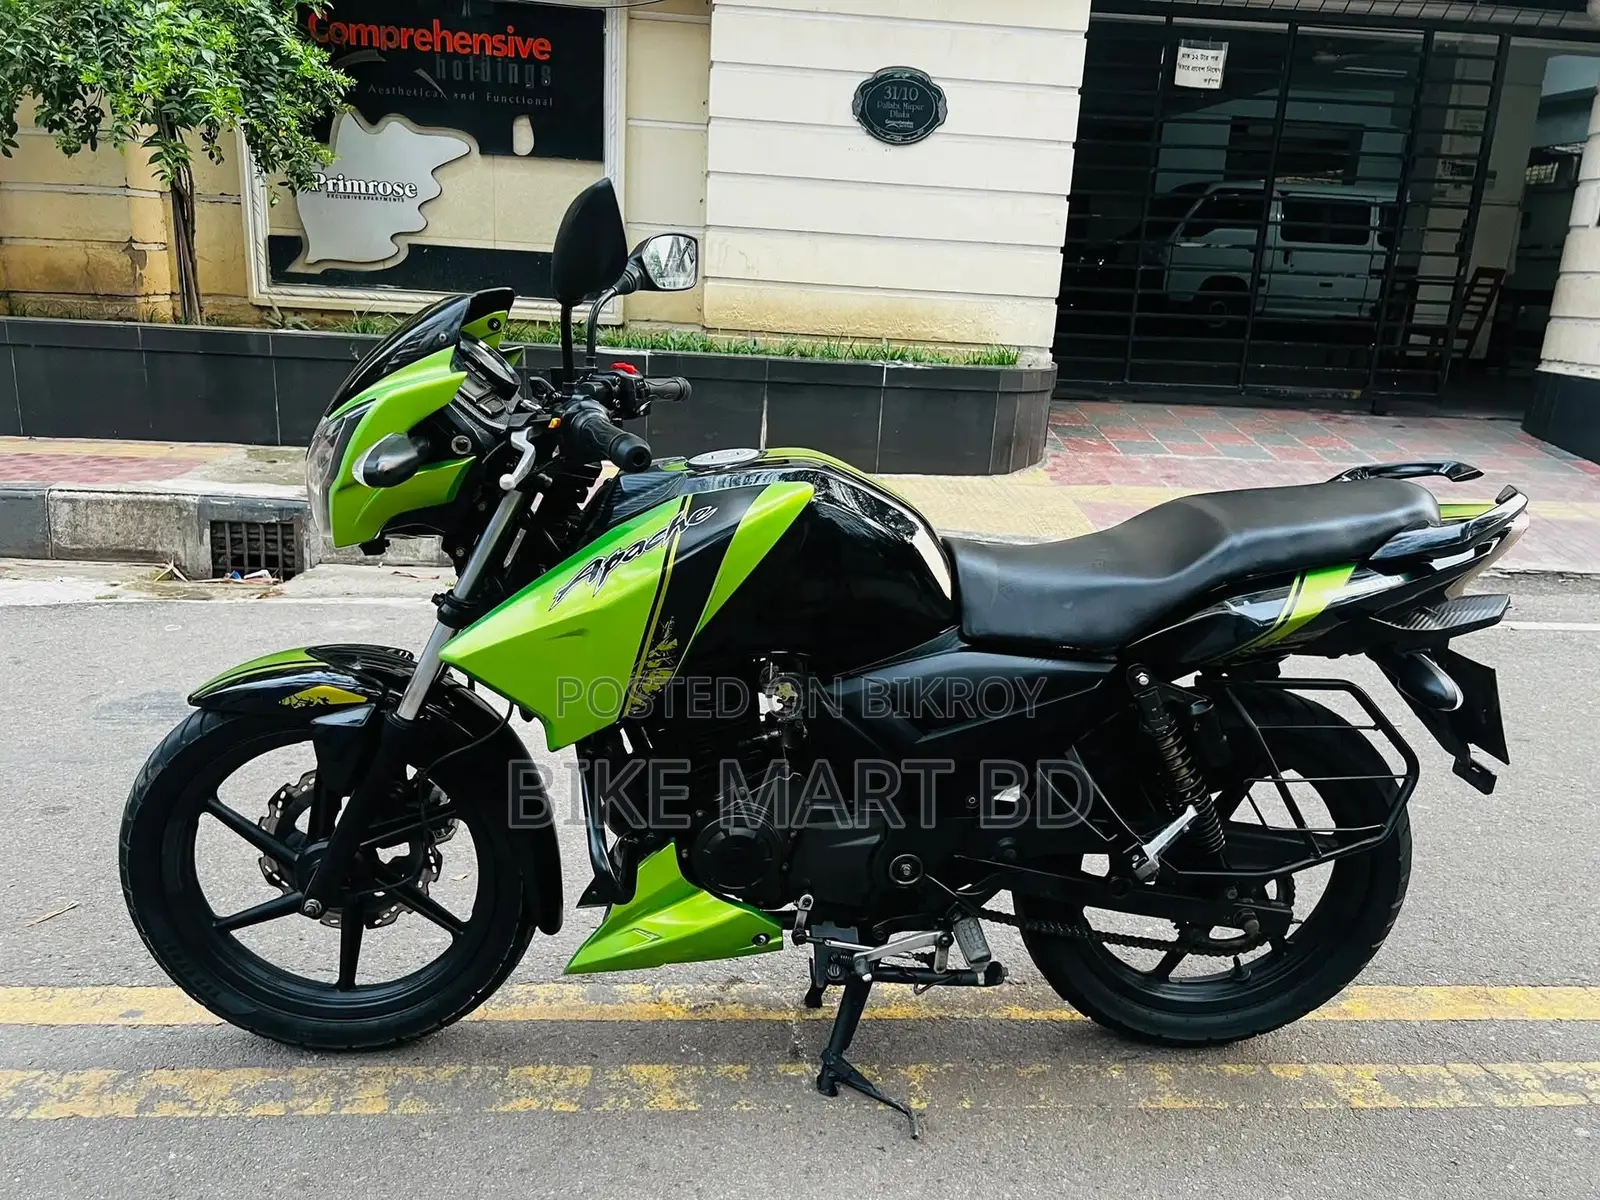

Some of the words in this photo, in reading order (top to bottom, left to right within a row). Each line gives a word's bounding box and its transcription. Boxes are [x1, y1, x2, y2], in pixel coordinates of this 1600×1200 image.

[308, 12, 552, 60] Comprehensive
[435, 54, 552, 89] holdings
[453, 91, 475, 101] and
[486, 92, 553, 107] Functional
[884, 85, 918, 101] 31/10
[311, 172, 418, 198] Primrose
[548, 506, 718, 612] Apache
